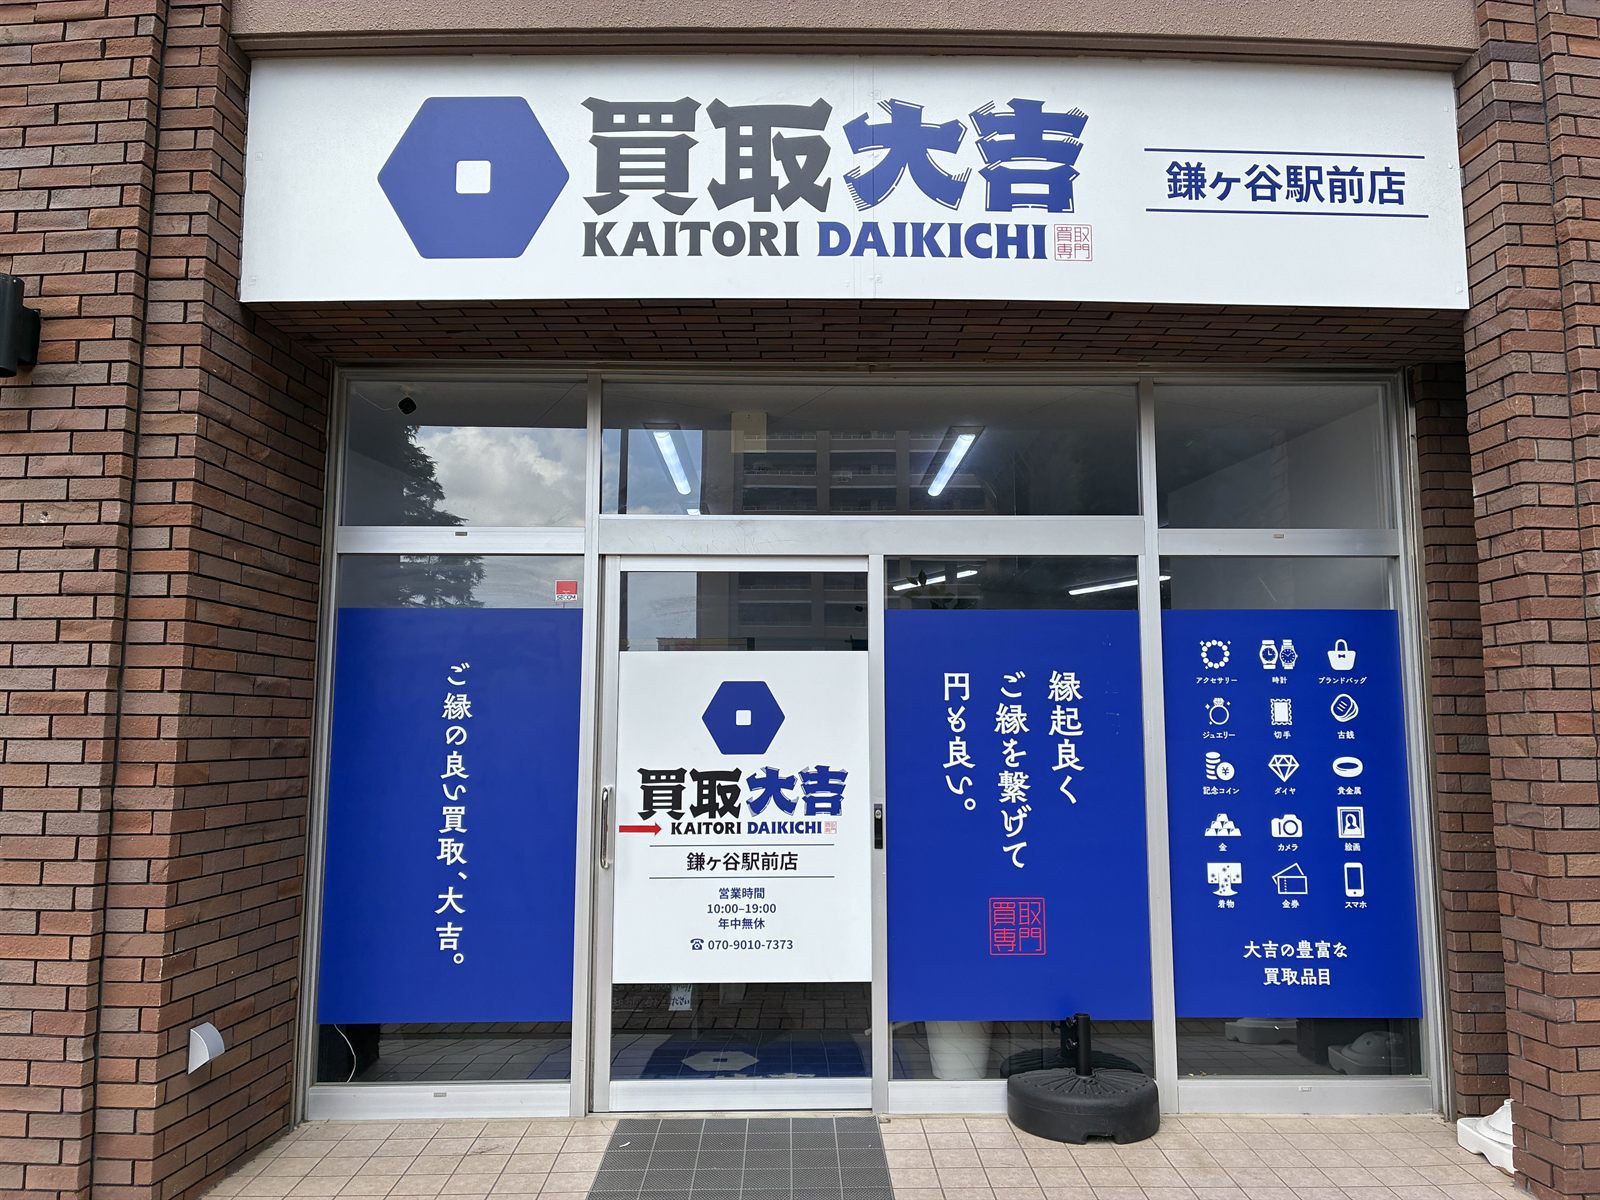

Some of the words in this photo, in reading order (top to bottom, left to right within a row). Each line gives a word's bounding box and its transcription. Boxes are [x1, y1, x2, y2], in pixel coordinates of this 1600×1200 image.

[580, 96, 1089, 216] 買取大吉
[1165, 160, 1406, 206] 鎌ヶ谷駅前店
[581, 220, 800, 257] KAITORI
[816, 221, 1048, 260] DAIKICHI
[1196, 676, 1238, 685] アクセサリー
[1271, 676, 1288, 684] 時計
[1318, 676, 1368, 685] ブランドバッグ
[1047, 670, 1085, 805] 縁起良く
[1202, 730, 1236, 740] ジュエリー
[1273, 730, 1292, 740] 切手
[1337, 730, 1355, 740] 古銭
[942, 672, 977, 811] 円も良い。
[993, 670, 1032, 869] ご縁を繋げて
[636, 764, 849, 821] 買取大吉
[1202, 785, 1240, 796] 記念コイン
[1274, 786, 1296, 795] ダイヤ
[1337, 786, 1362, 795] 貴金属
[434, 662, 473, 965] ご縁の良い買取、大吉。
[669, 820, 742, 835] KAITORI
[746, 820, 822, 835] DAIKICHI
[1218, 842, 1228, 852] 金
[1277, 843, 1299, 852] カメラ
[1344, 842, 1361, 852] 絵画
[686, 851, 799, 872] 鎌ヶ谷駅前店
[718, 887, 766, 900] 営業時間
[1217, 899, 1235, 909] 着物
[1281, 899, 1300, 909] 金券
[1344, 900, 1368, 909] スマホ
[718, 917, 766, 930] 年中無休
[707, 939, 794, 950] 070-9010-7373
[1243, 939, 1348, 959] 大吉の豊富な
[1263, 967, 1331, 986] 買取品目
